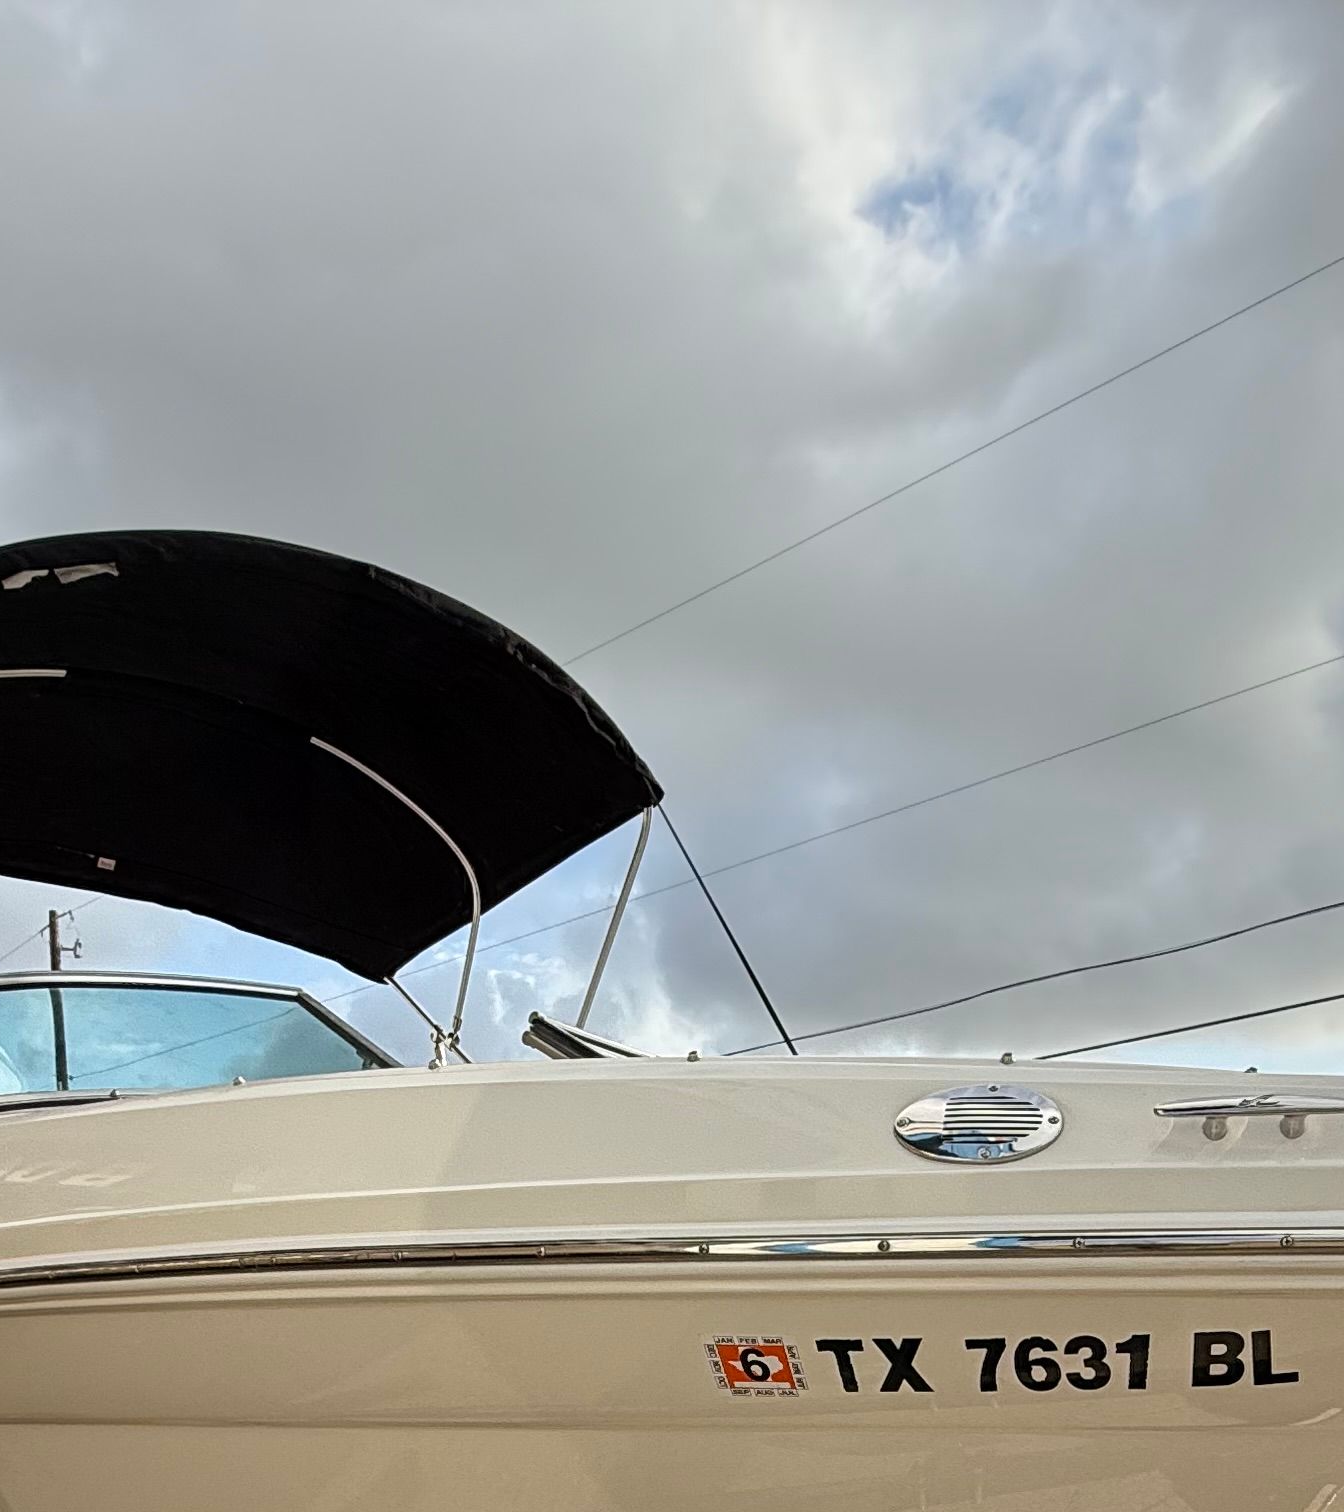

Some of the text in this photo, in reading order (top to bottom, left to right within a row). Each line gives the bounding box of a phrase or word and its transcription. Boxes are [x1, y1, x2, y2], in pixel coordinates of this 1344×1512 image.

[739, 1348, 771, 1382] 6
[815, 1330, 1300, 1393] TX 7631 BL
